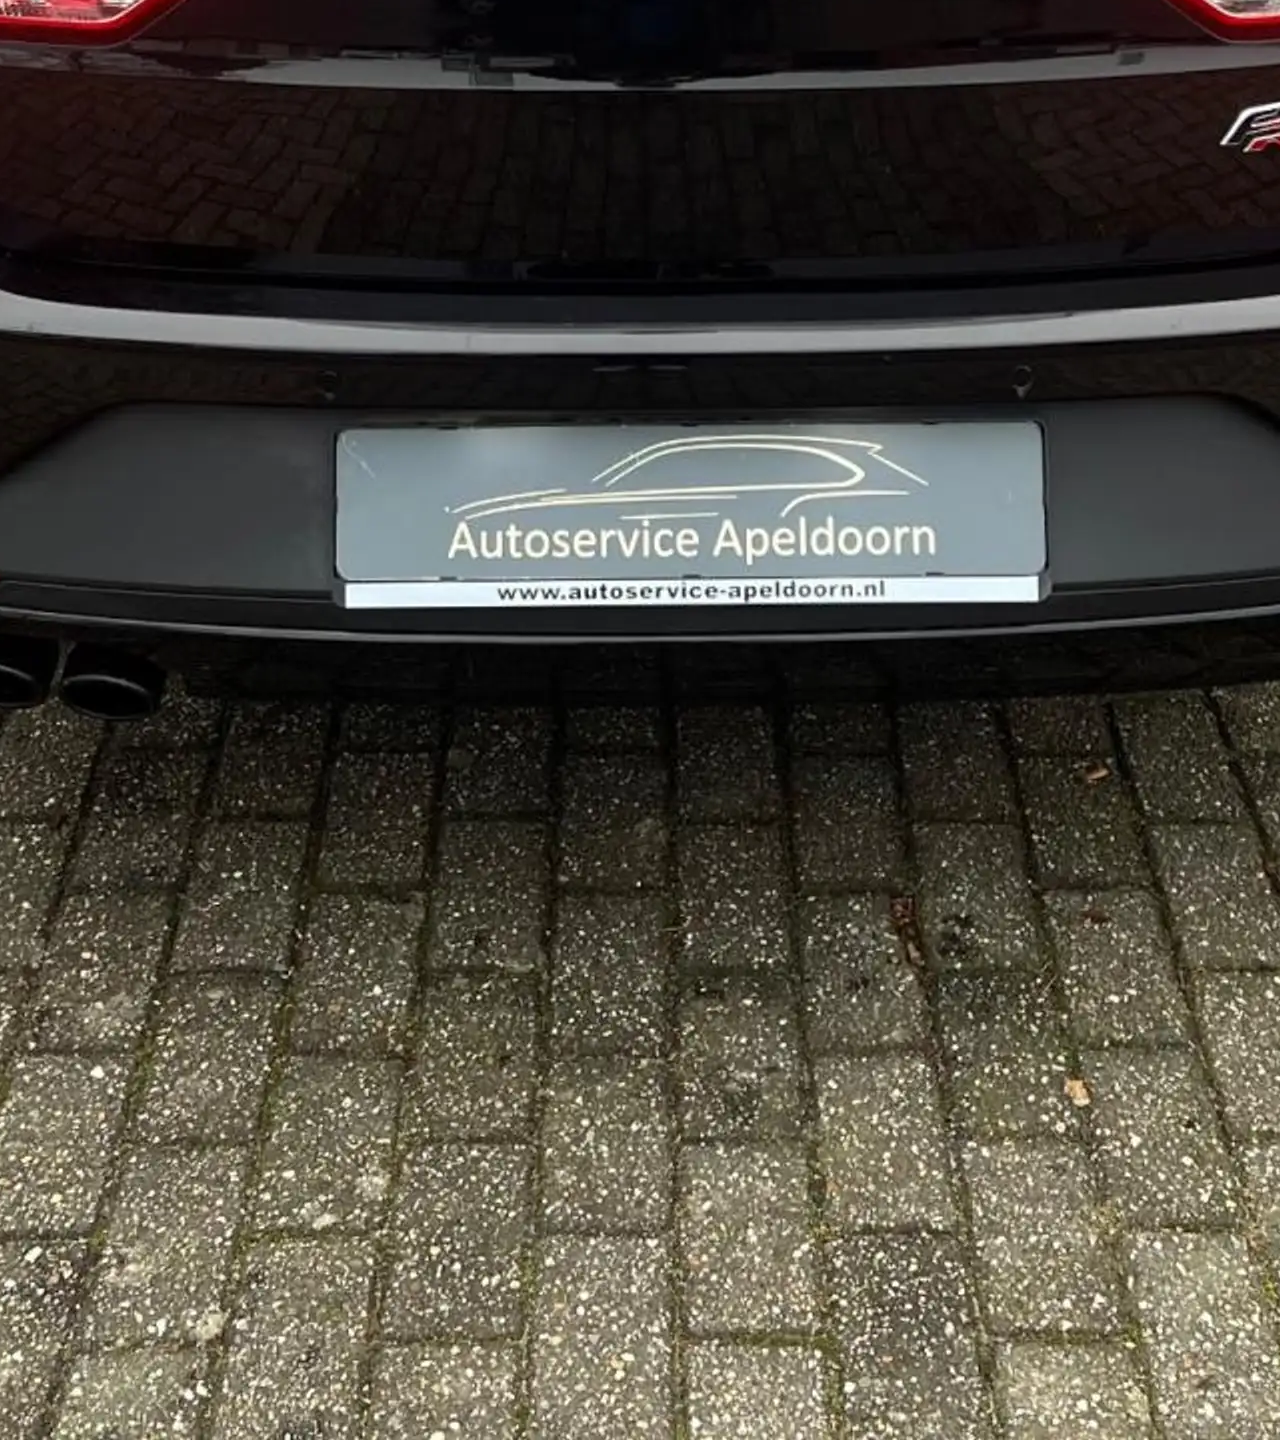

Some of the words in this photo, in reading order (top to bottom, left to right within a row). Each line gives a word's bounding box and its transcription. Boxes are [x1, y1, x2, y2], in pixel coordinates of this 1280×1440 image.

[447, 519, 700, 559] Autoservice
[712, 515, 937, 566] Apeldoorn
[497, 579, 886, 603] www.autoservice-apeldoorn.nl
